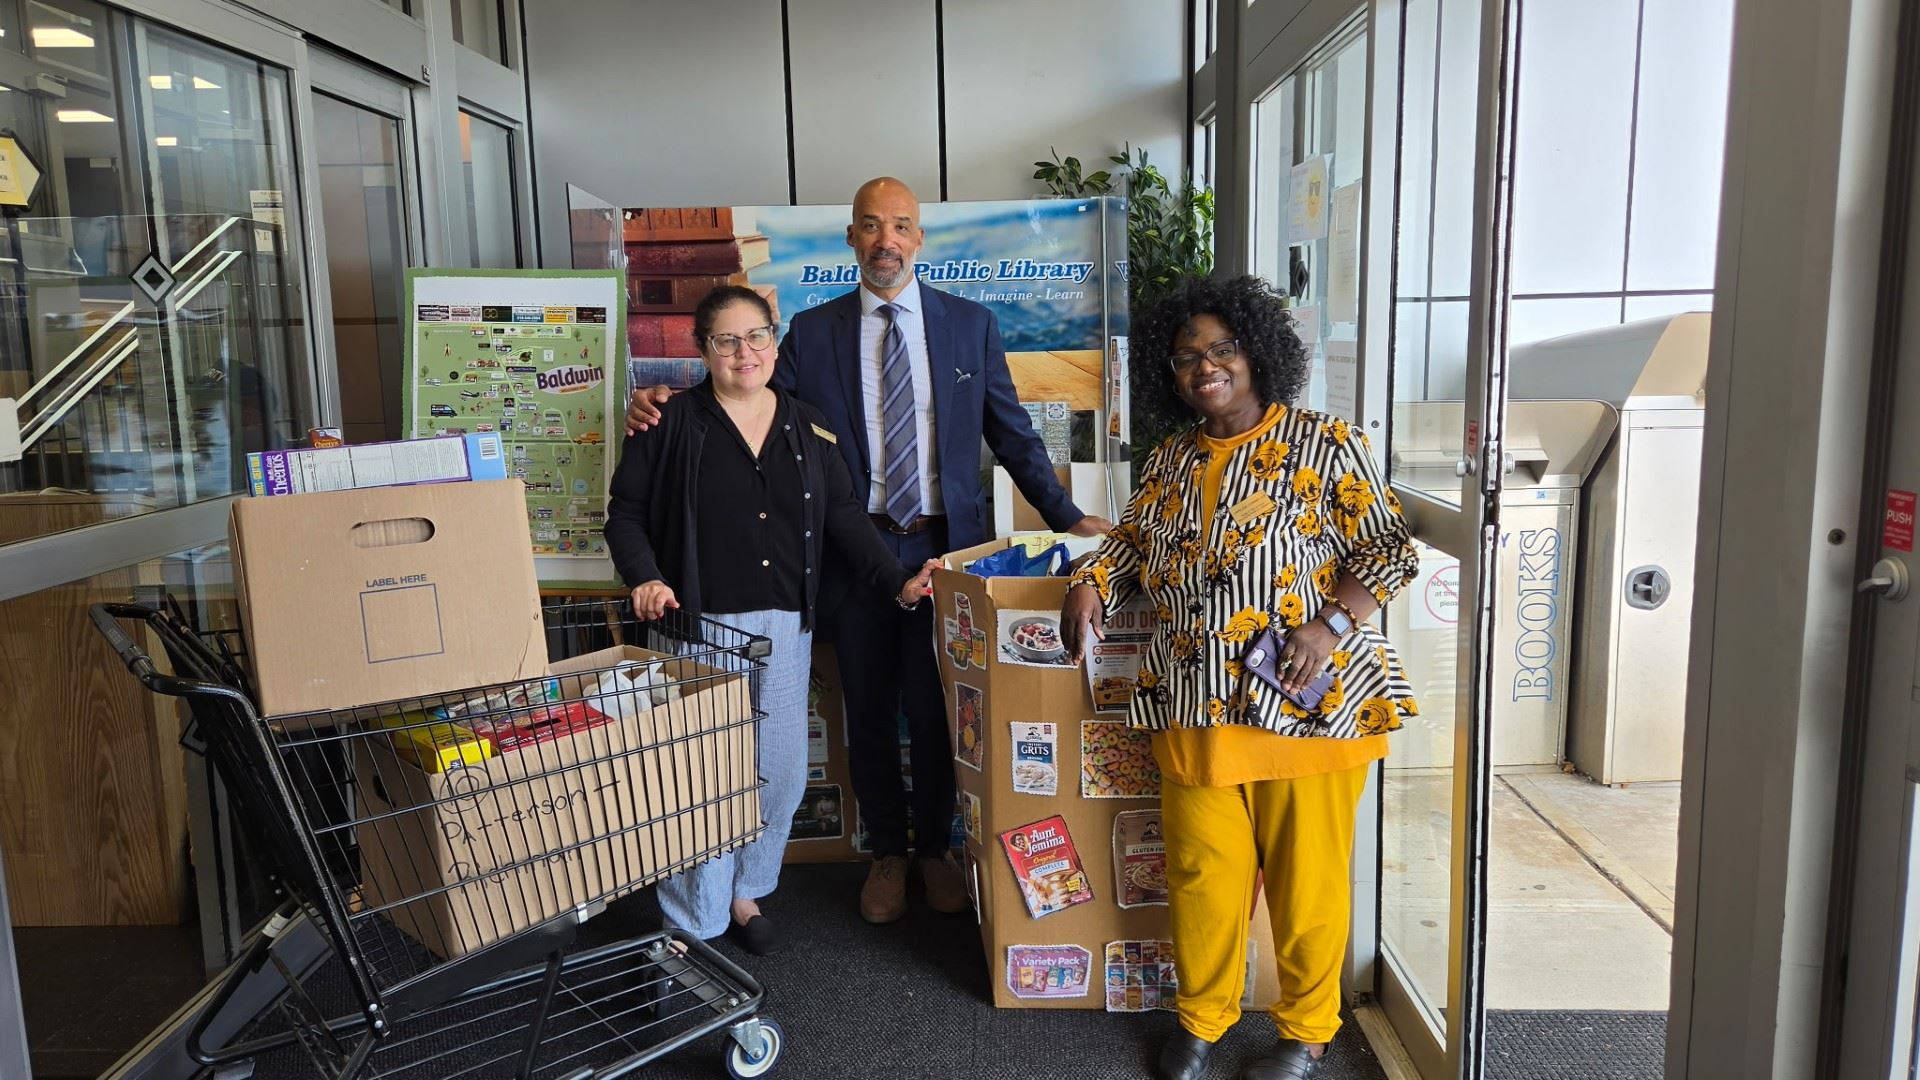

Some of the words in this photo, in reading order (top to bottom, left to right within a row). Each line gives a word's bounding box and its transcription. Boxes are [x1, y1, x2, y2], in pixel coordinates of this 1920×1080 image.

[799, 263, 862, 285] Bald
[913, 260, 992, 283] Public
[996, 259, 1094, 284] Library
[980, 289, 1033, 304] Imagine
[1046, 287, 1084, 300] Learn
[536, 363, 604, 390] Baldwin
[271, 454, 289, 496] Cheerios
[1886, 509, 1913, 525] PUSH
[366, 577, 398, 588] LABEL
[399, 573, 427, 584] HERE
[1106, 611, 1135, 630] OOD
[1512, 527, 1561, 702] BOOKS
[1021, 744, 1049, 756] GRITS
[1030, 826, 1056, 843] Aunt
[1024, 835, 1066, 858] Jemima
[1034, 861, 1065, 874] COMPLETE
[1022, 956, 1057, 968] Variety
[1058, 955, 1080, 965] Pack
